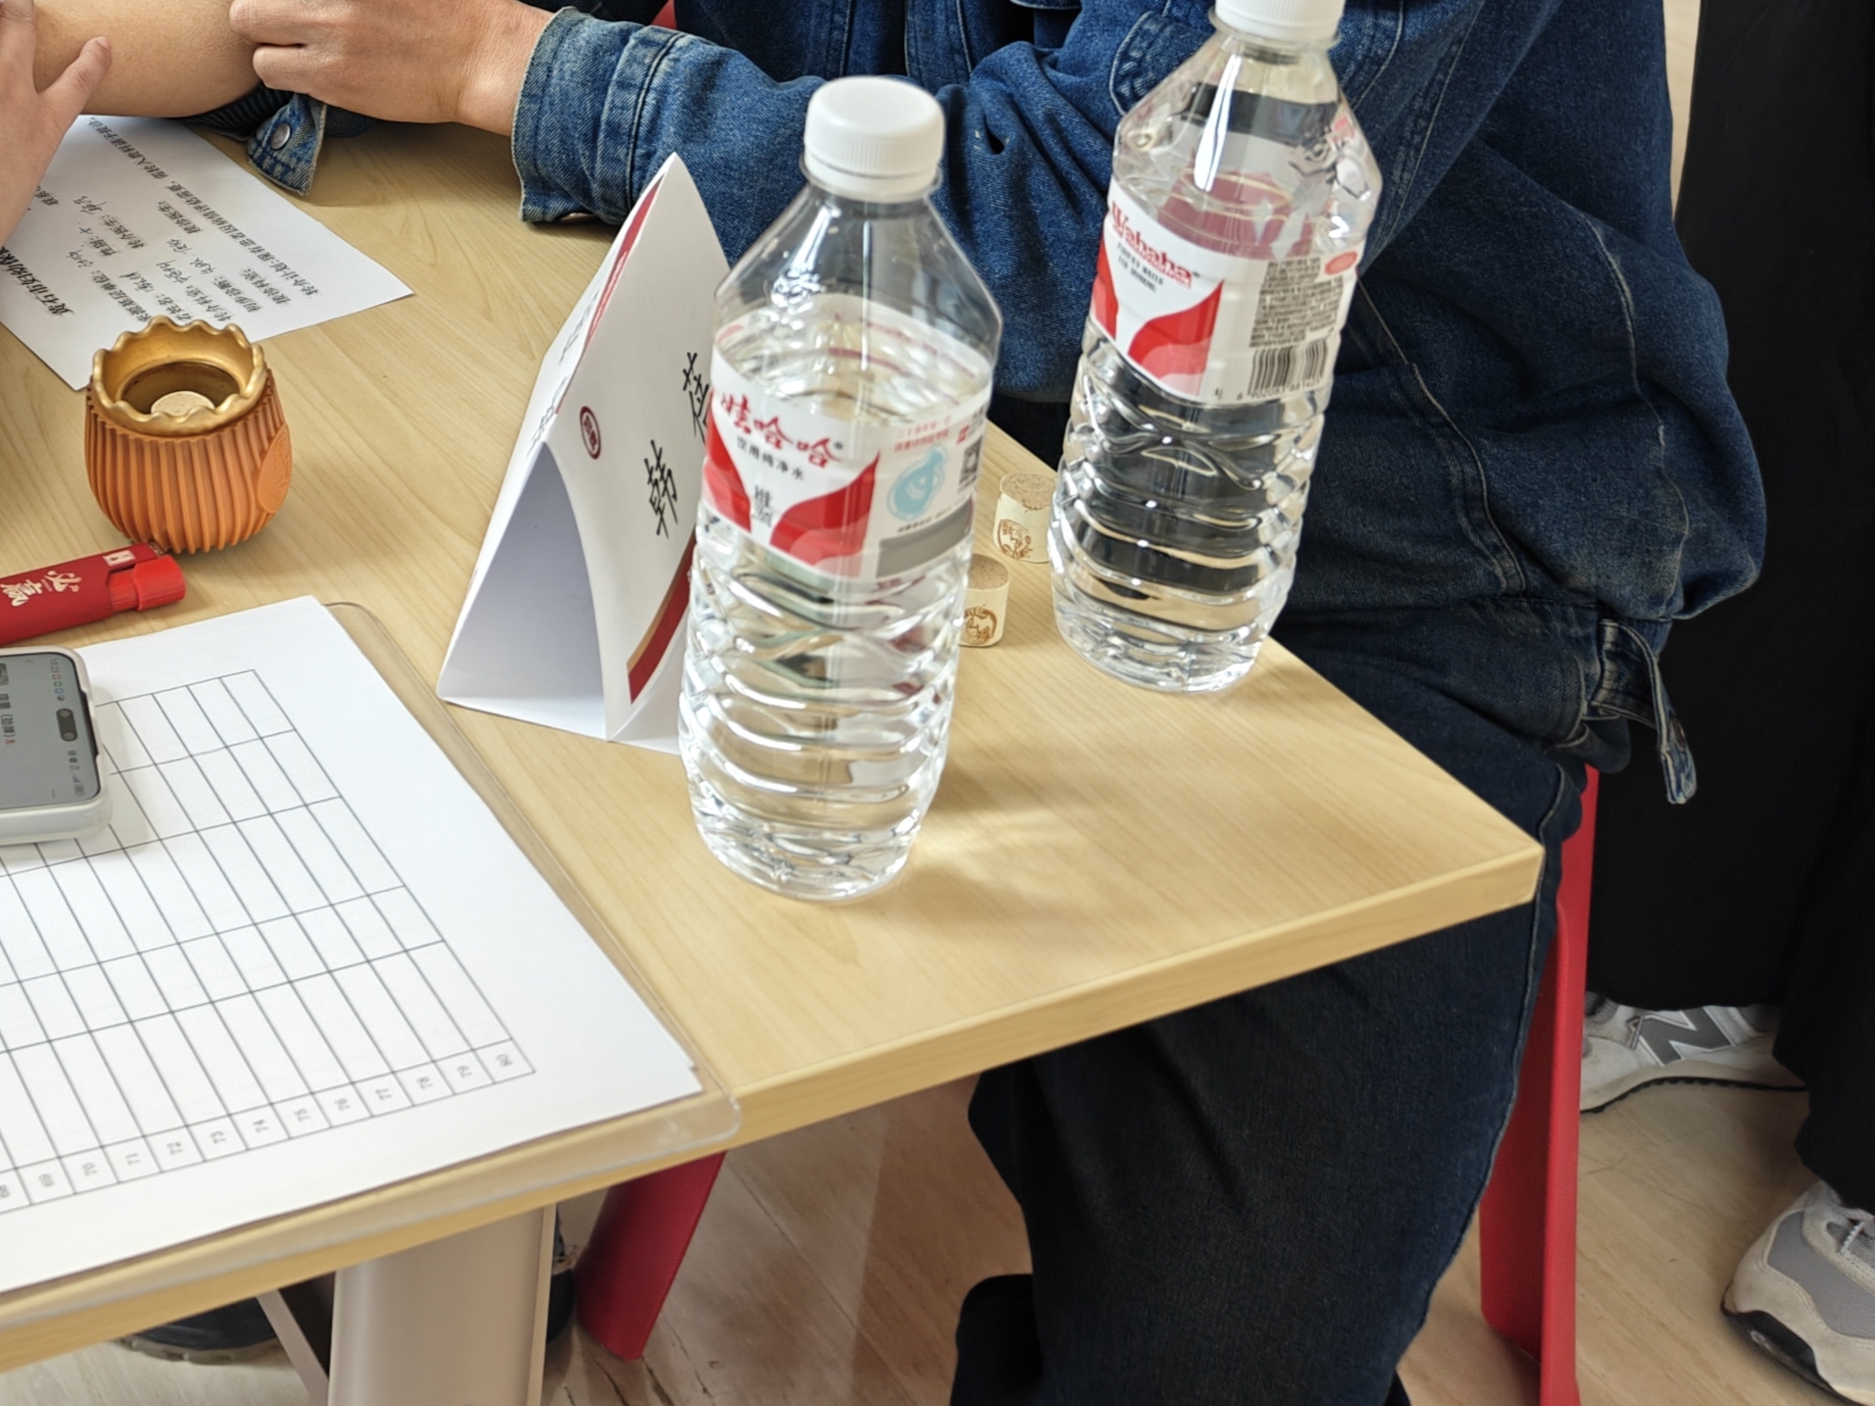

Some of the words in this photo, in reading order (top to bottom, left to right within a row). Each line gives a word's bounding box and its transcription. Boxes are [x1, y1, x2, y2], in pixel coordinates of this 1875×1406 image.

[156, 293, 193, 324] 者姓名：
[720, 394, 843, 469] 娃哈哈
